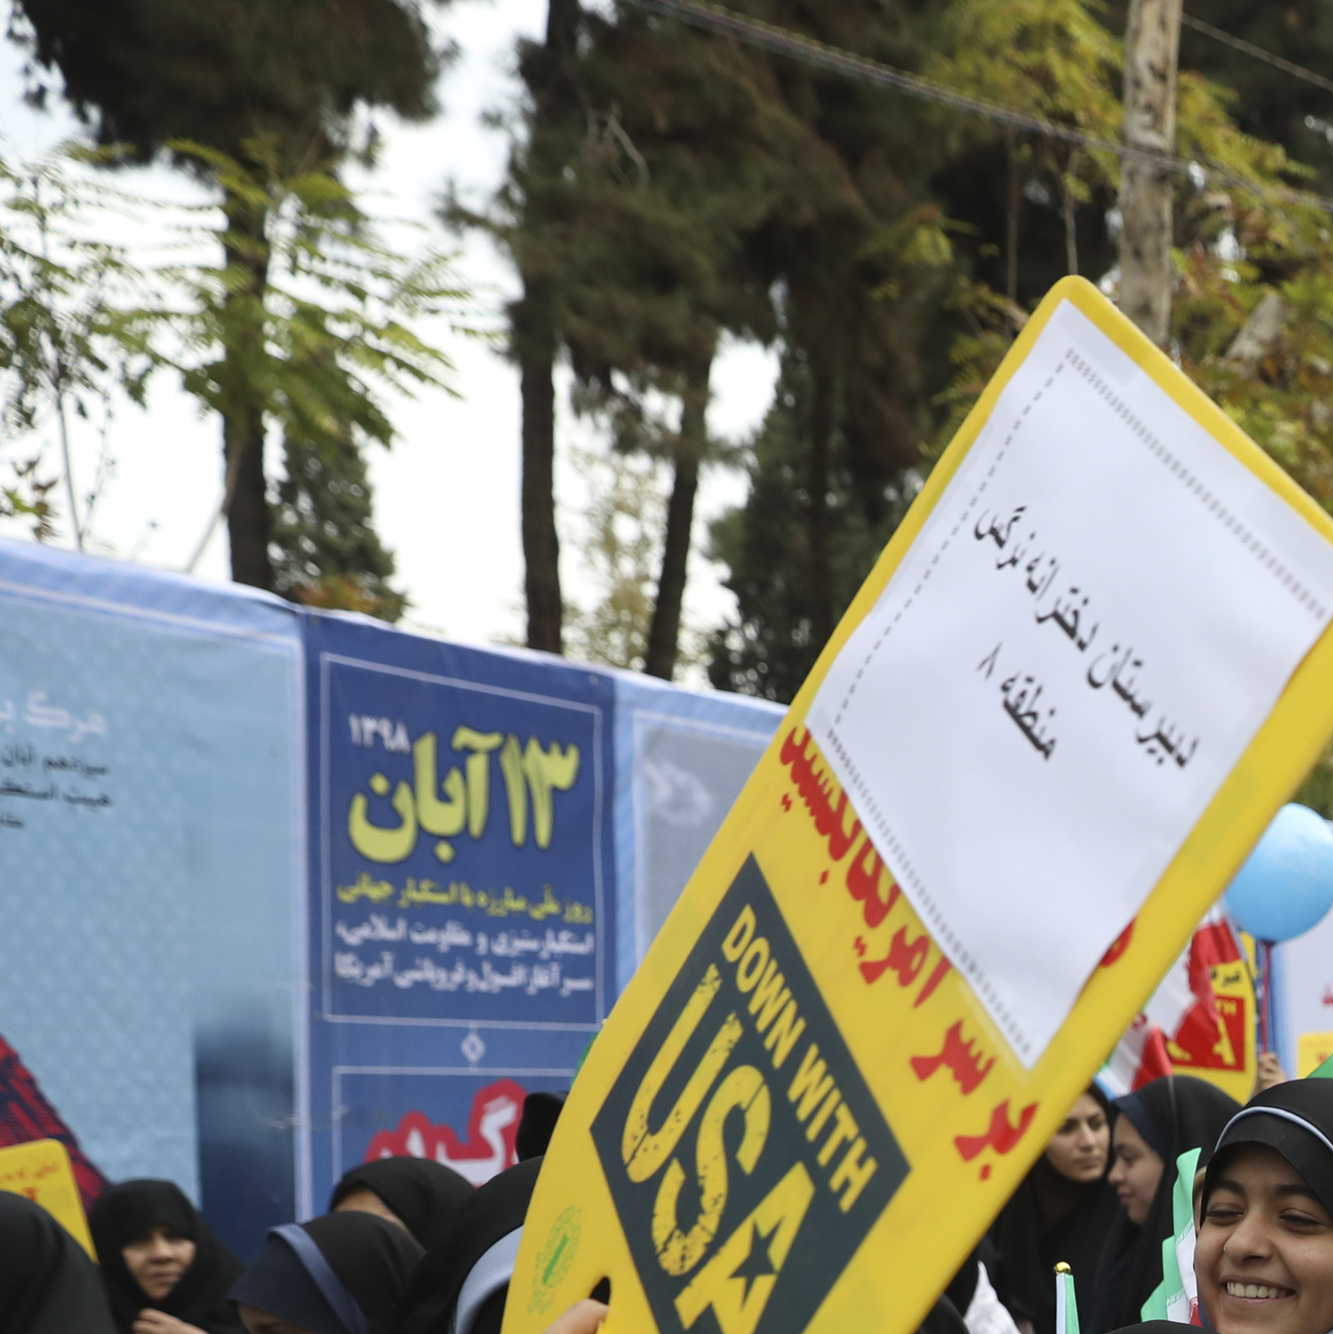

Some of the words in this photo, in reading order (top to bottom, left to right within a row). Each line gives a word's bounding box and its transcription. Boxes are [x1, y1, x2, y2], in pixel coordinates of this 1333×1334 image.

[1000, 671, 1061, 764] منطقه
[347, 723, 505, 865] آبان
[720, 903, 806, 1073] DOWN
[786, 1040, 880, 1214] WITH
[908, 1017, 1000, 1097] سر
[952, 1099, 1041, 1184] بر
